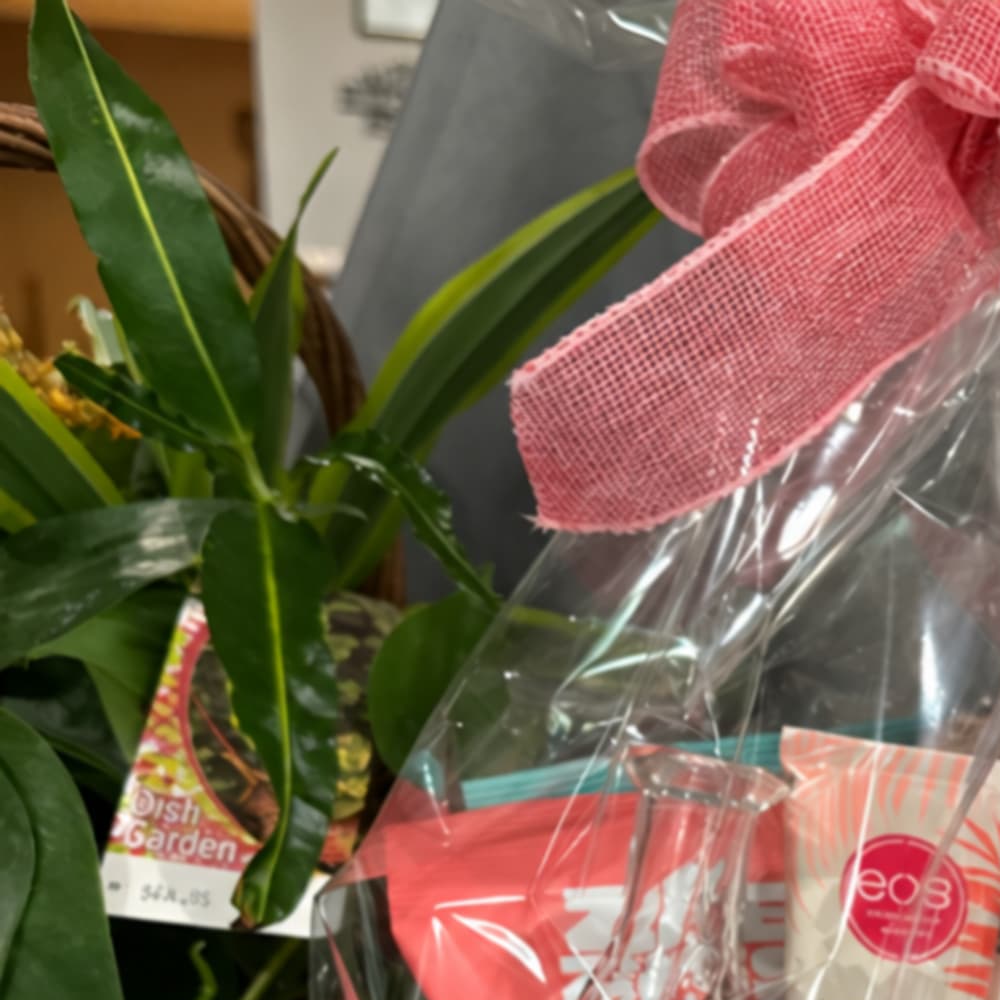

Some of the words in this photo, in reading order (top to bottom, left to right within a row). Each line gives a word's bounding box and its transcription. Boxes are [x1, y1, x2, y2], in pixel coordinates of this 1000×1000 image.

[131, 788, 199, 825] Dish
[123, 819, 237, 863] Garden
[857, 868, 952, 910] eos
